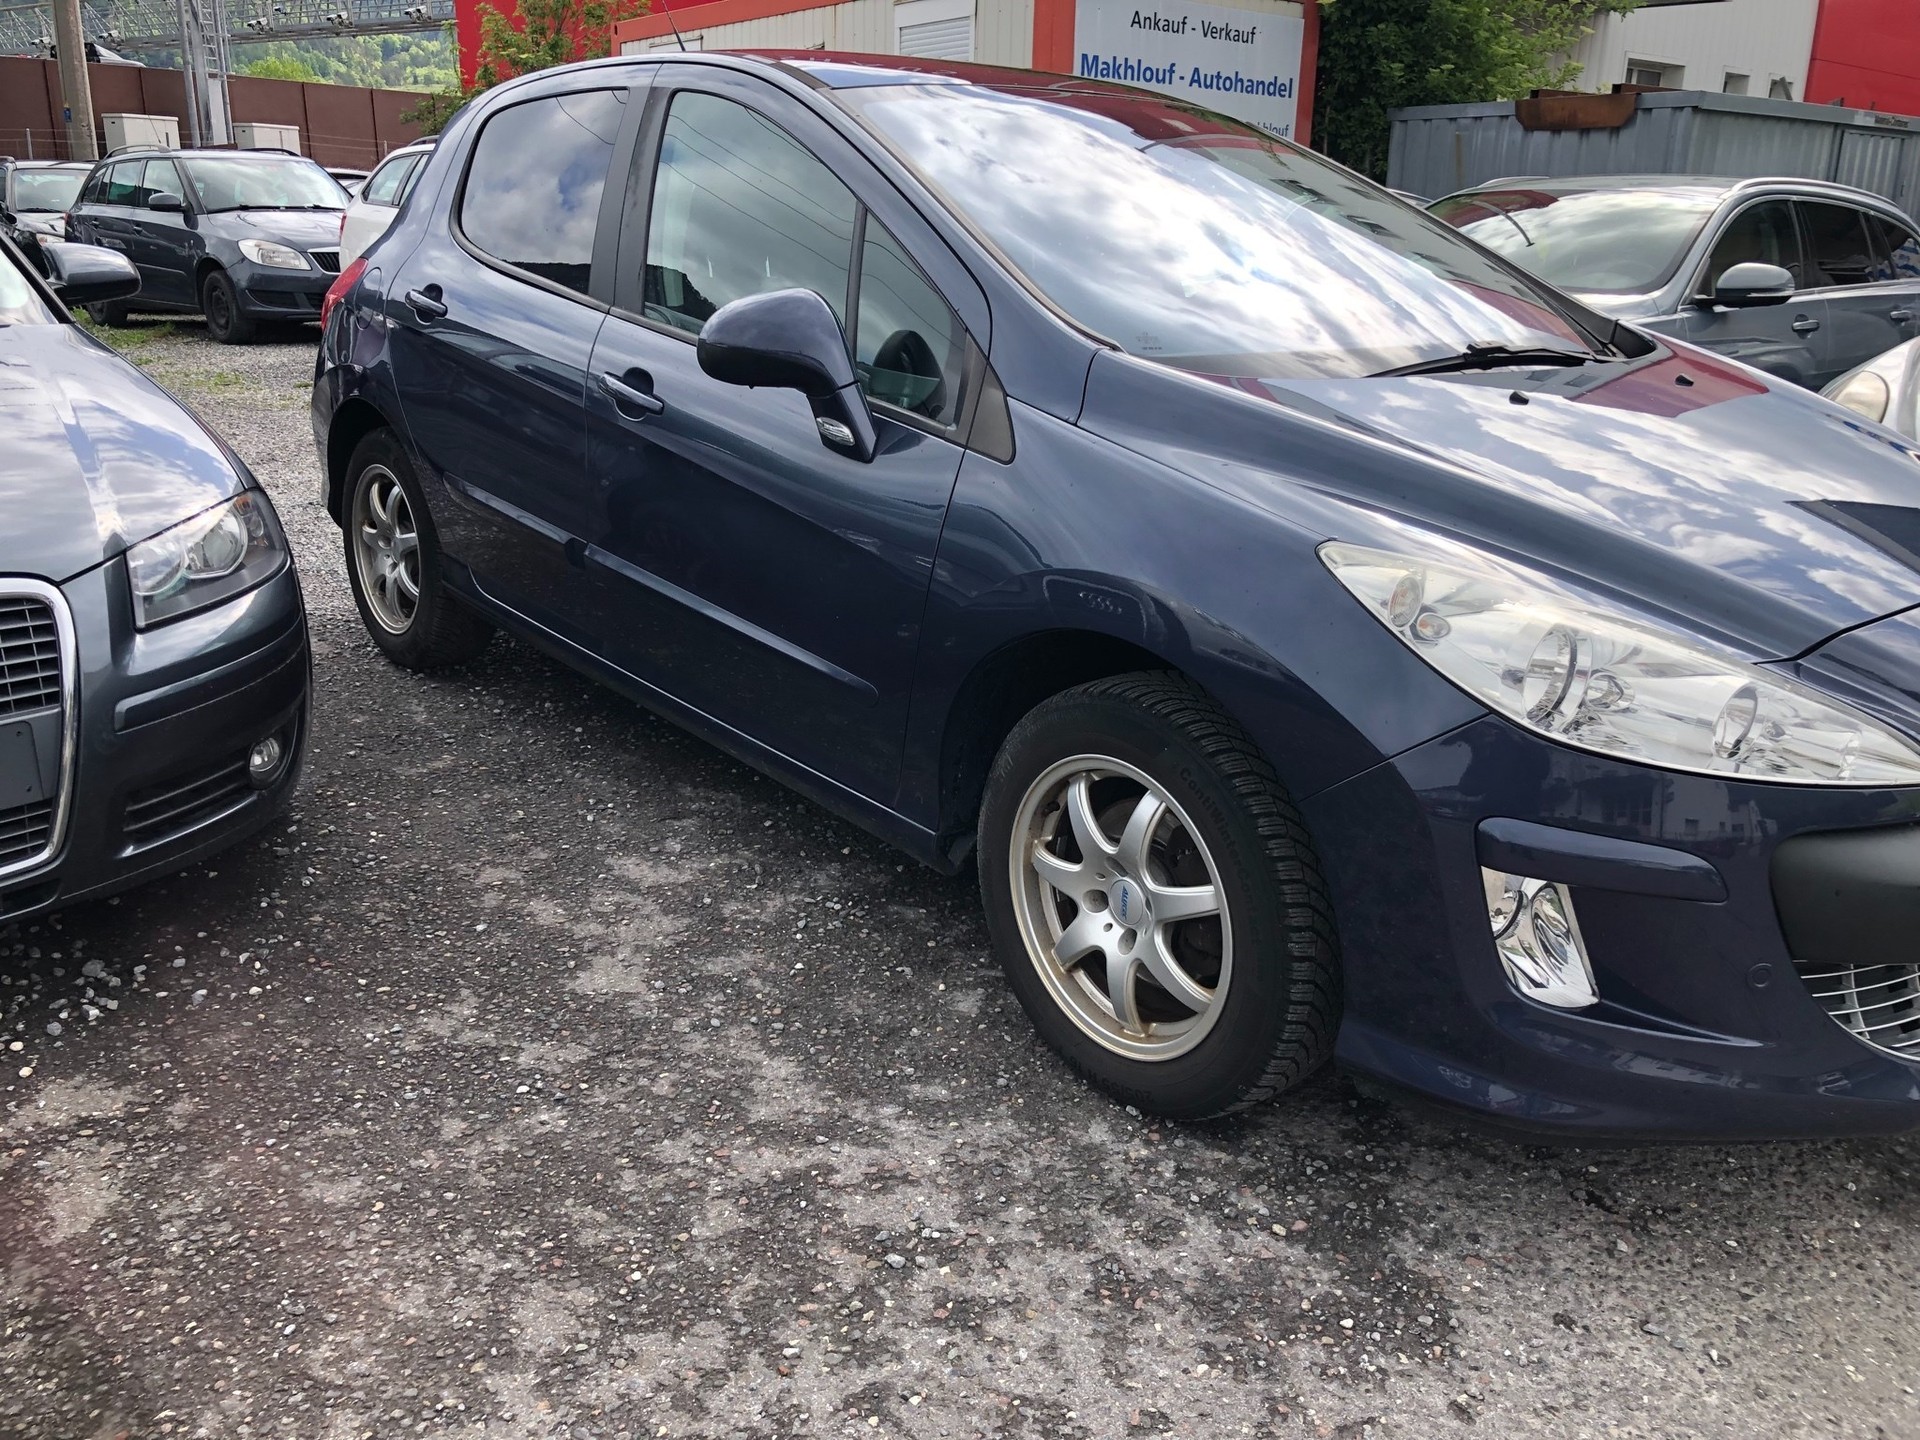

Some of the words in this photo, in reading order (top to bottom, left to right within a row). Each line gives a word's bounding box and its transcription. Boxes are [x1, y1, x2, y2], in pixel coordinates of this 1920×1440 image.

[1130, 10, 1188, 35] Ankauf
[1201, 20, 1257, 45] Verkauf
[1080, 53, 1176, 85] Makhlouf
[1188, 67, 1294, 99] Autohandel
